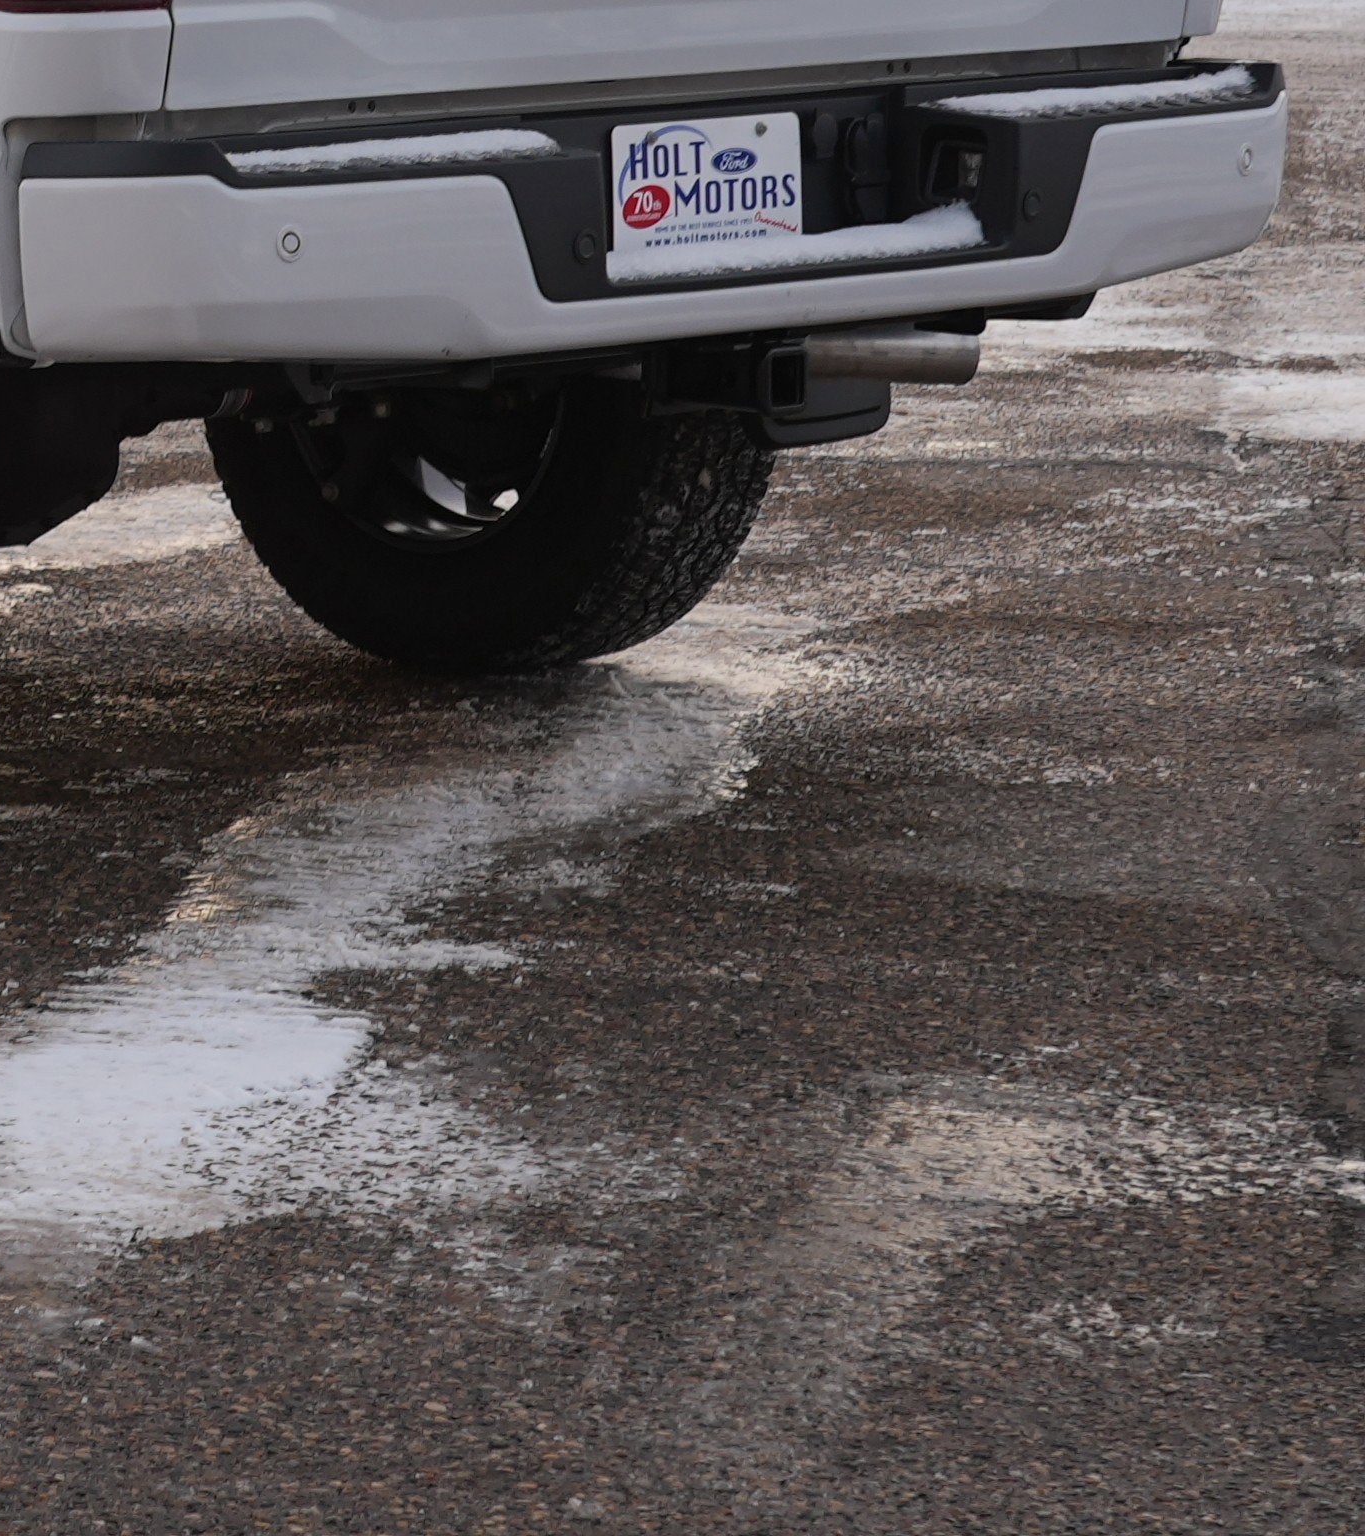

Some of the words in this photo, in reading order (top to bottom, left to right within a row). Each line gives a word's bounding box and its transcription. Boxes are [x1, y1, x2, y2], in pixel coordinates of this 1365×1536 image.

[629, 141, 705, 180] HOLT
[674, 173, 796, 217] MOTORS
[645, 228, 767, 248] www.holtmotors.com
